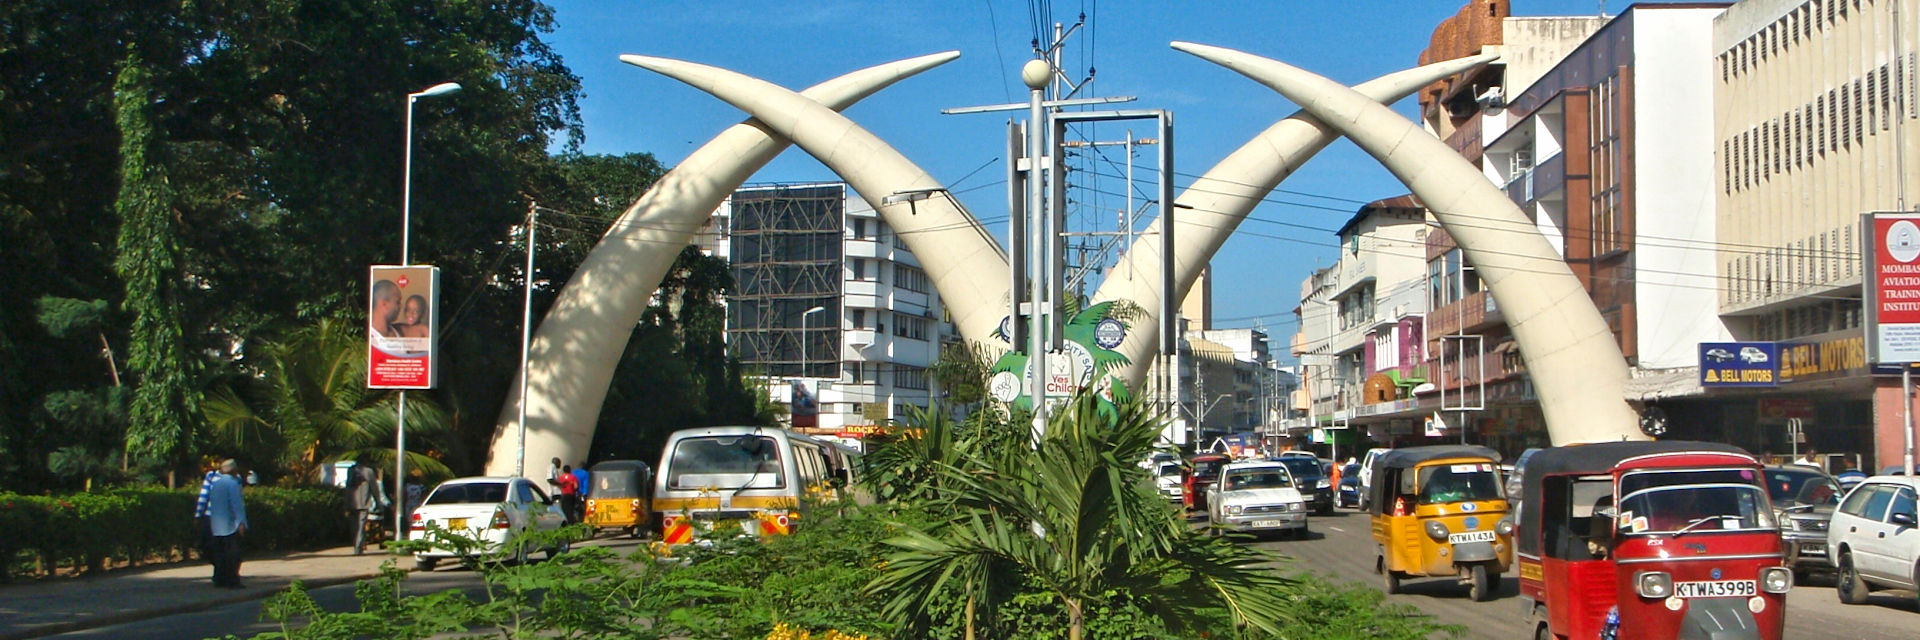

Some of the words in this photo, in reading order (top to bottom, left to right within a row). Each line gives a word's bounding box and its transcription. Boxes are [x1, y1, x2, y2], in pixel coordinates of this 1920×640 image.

[1063, 343, 1085, 358] CITY
[1794, 345, 1818, 375] BELL
[1820, 337, 1864, 370] MOTORS
[1052, 375, 1069, 383] Yes
[1721, 369, 1740, 382] BELL
[1742, 369, 1772, 382] MOTORS
[1676, 581, 1755, 596] KTWA399B
